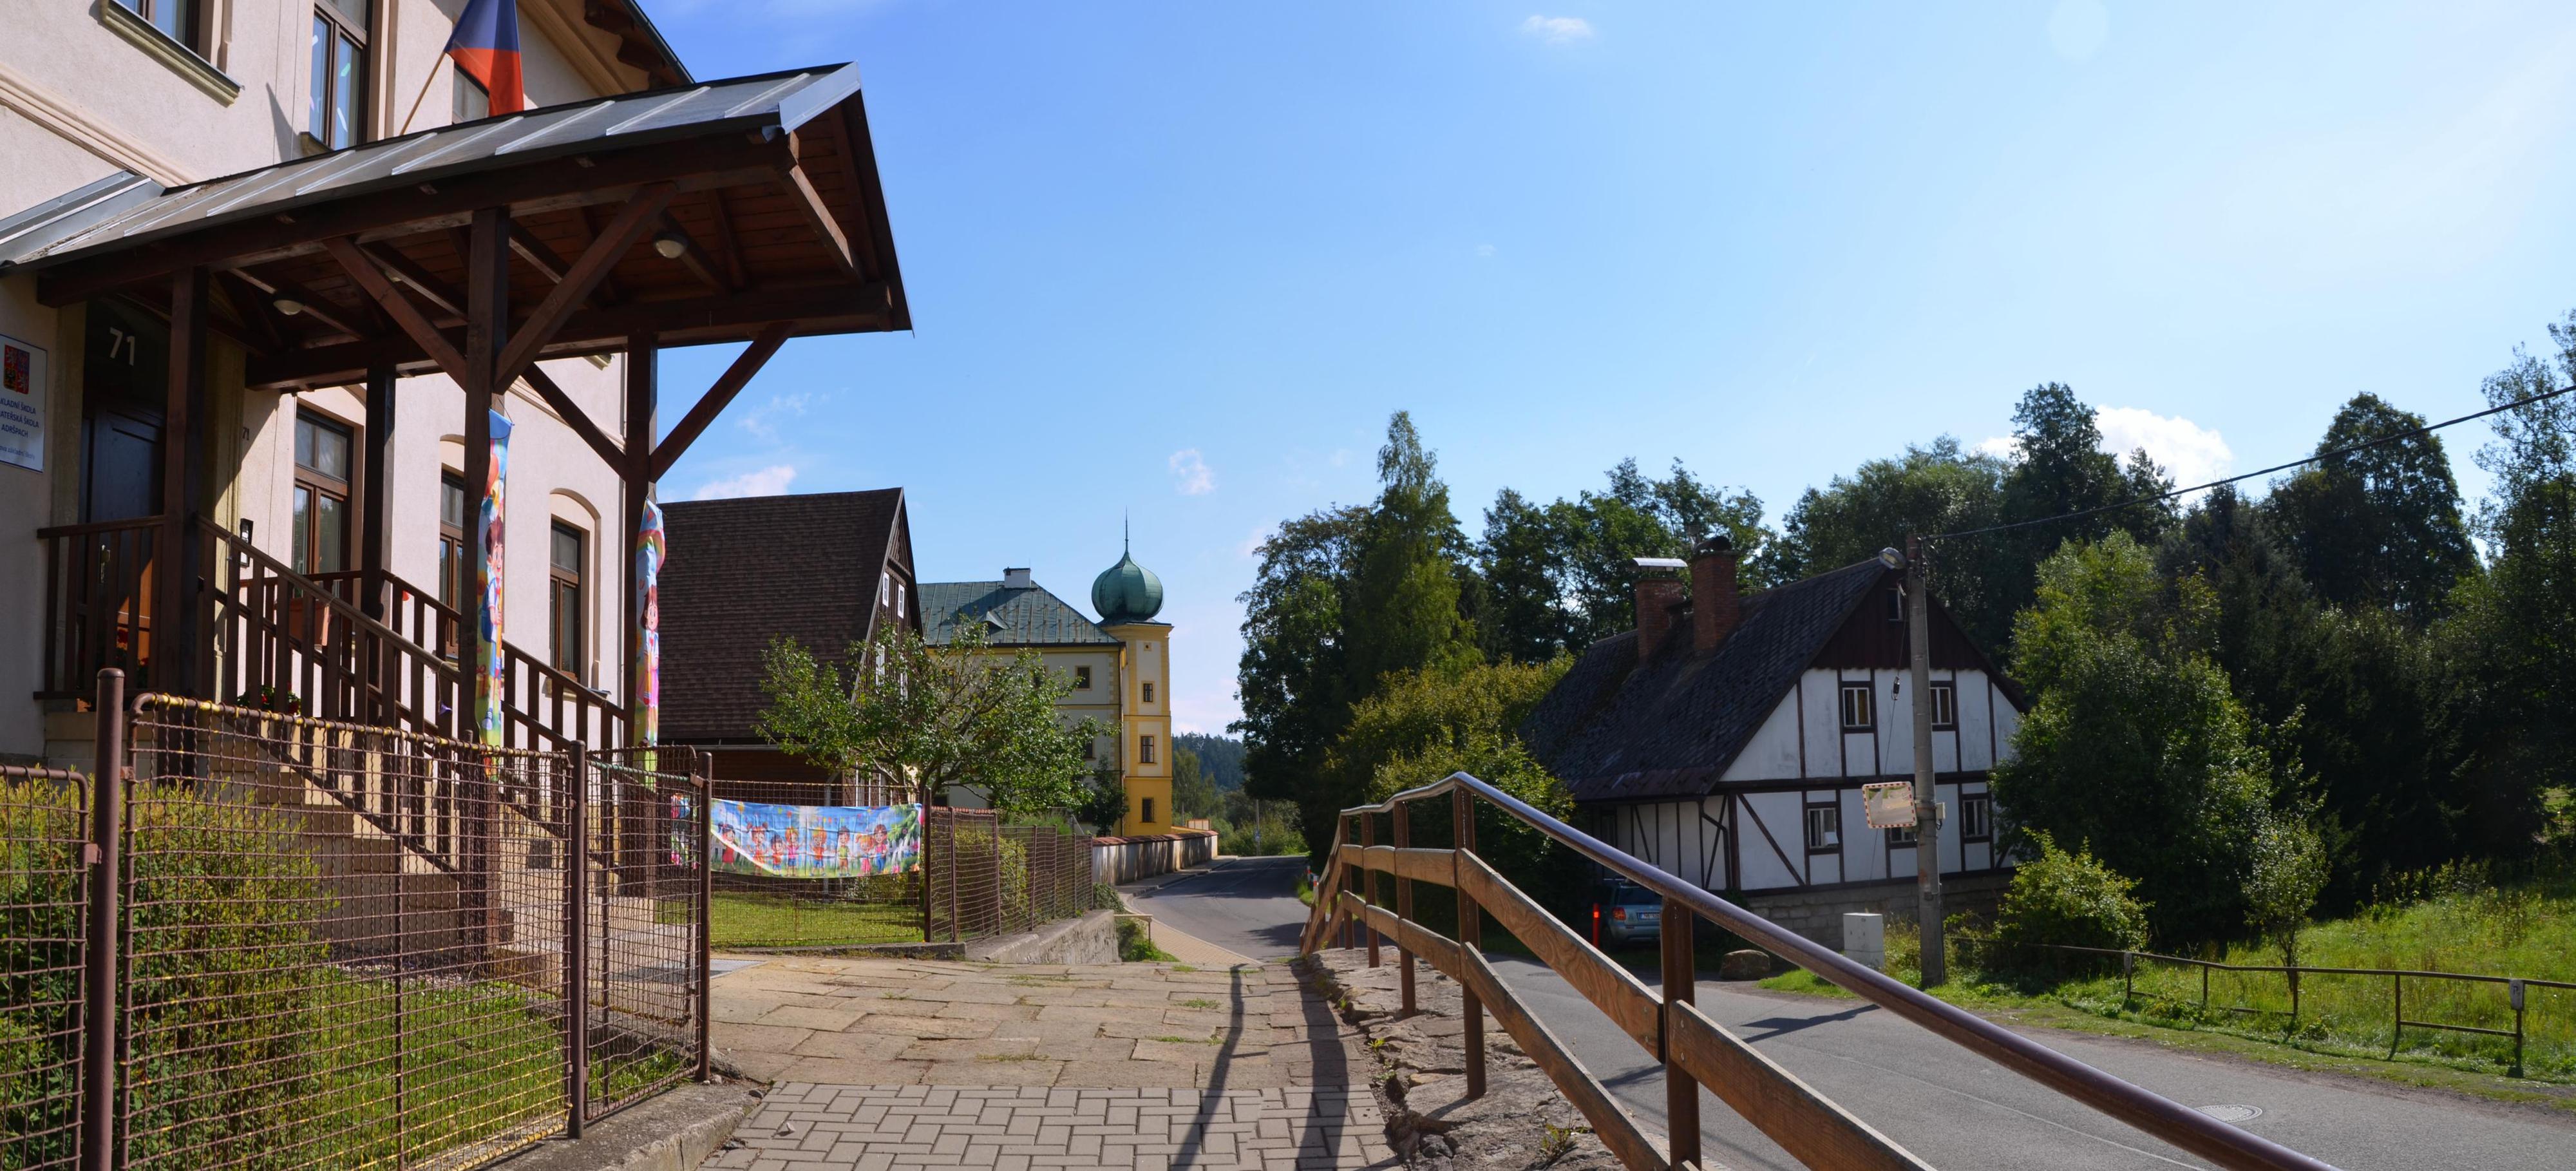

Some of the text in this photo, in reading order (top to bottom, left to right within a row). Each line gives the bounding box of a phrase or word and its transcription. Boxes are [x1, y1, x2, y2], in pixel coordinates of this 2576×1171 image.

[109, 327, 135, 366] 71
[0, 397, 36, 414] KLADNÍ ŠKOLA
[0, 410, 39, 428] ATEŘSKÁ ŠKOLA
[1, 423, 28, 438] ADRŠPACH
[242, 427, 250, 441] 71
